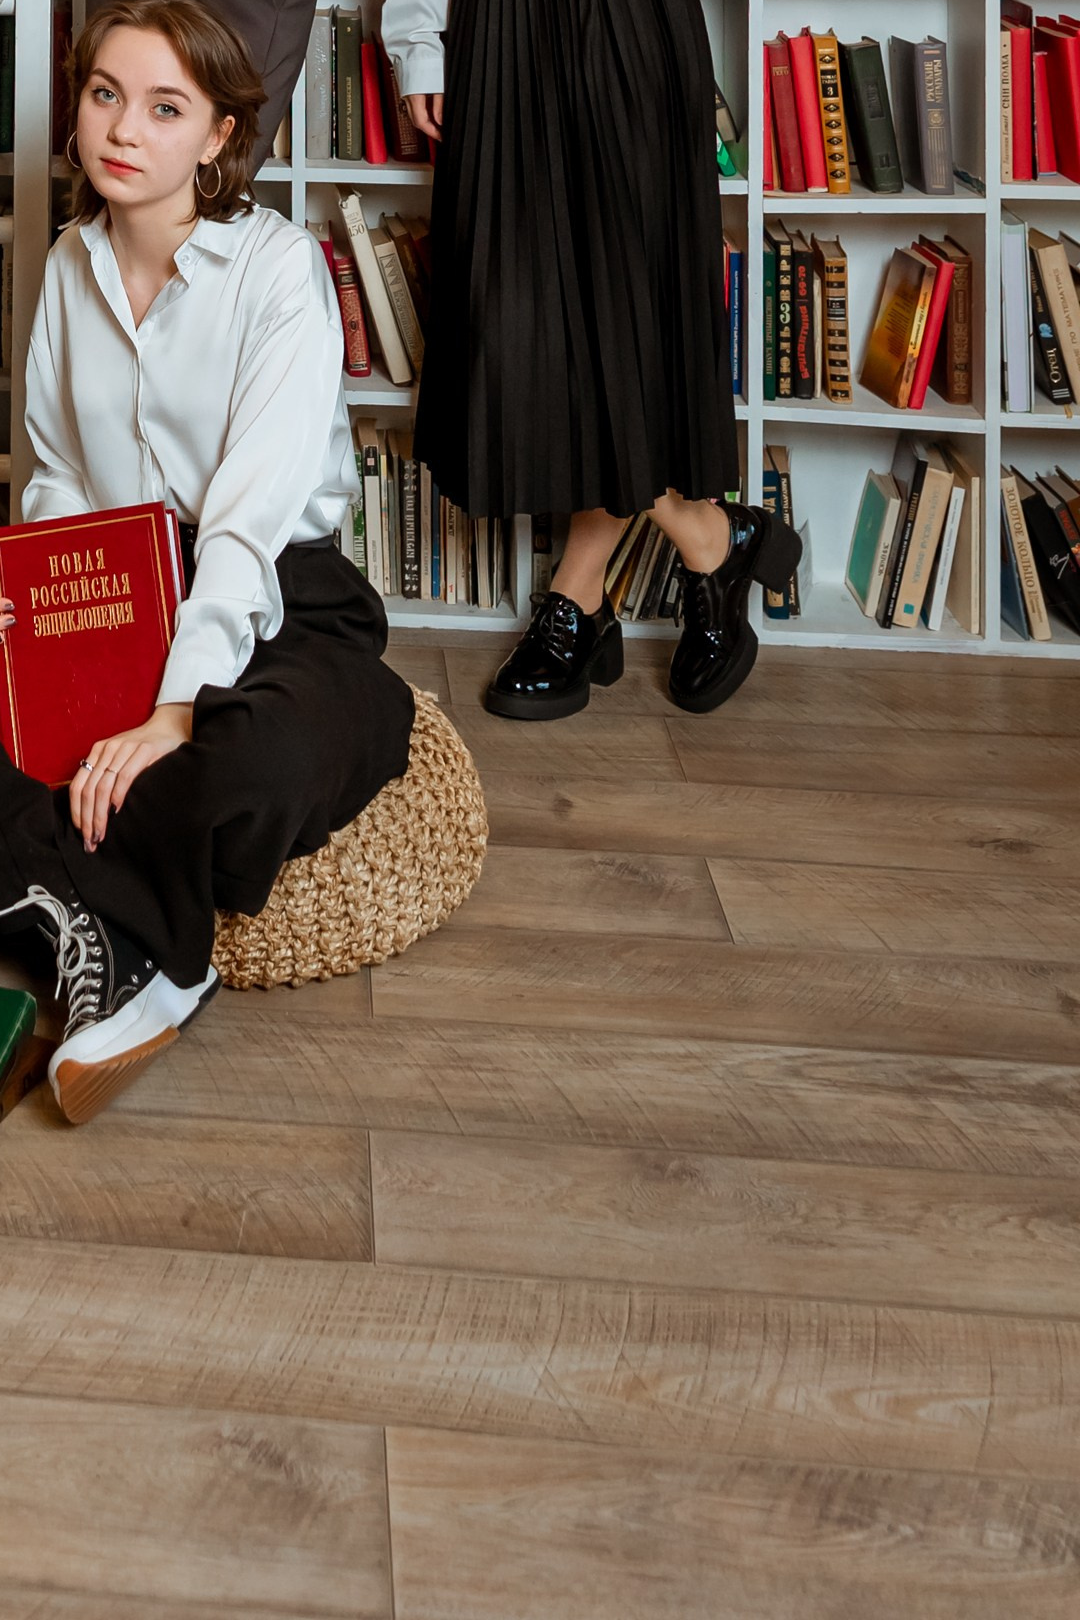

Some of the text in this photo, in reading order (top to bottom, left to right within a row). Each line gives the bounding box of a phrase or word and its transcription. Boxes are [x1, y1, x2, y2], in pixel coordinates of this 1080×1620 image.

[925, 61, 935, 102] РУССКИЕ
[933, 58, 943, 103] МЕМУАРЫ
[1001, 53, 1010, 84] ПОЛКА
[826, 86, 834, 96] 3
[1002, 88, 1010, 109] СЫН
[779, 242, 791, 301] ВЕРН
[797, 264, 808, 296] 69-70
[779, 326, 792, 394] ЖЮЛЬ
[404, 493, 414, 511] ГОД
[1004, 485, 1036, 587] ЗОЛОТОЕ КОЛЬЦО
[49, 548, 106, 578] НОВАЯ
[30, 573, 132, 609] РОССИЙСКАЯ
[33, 601, 135, 638] ЭНЦИКЛОПЕДИЯ
